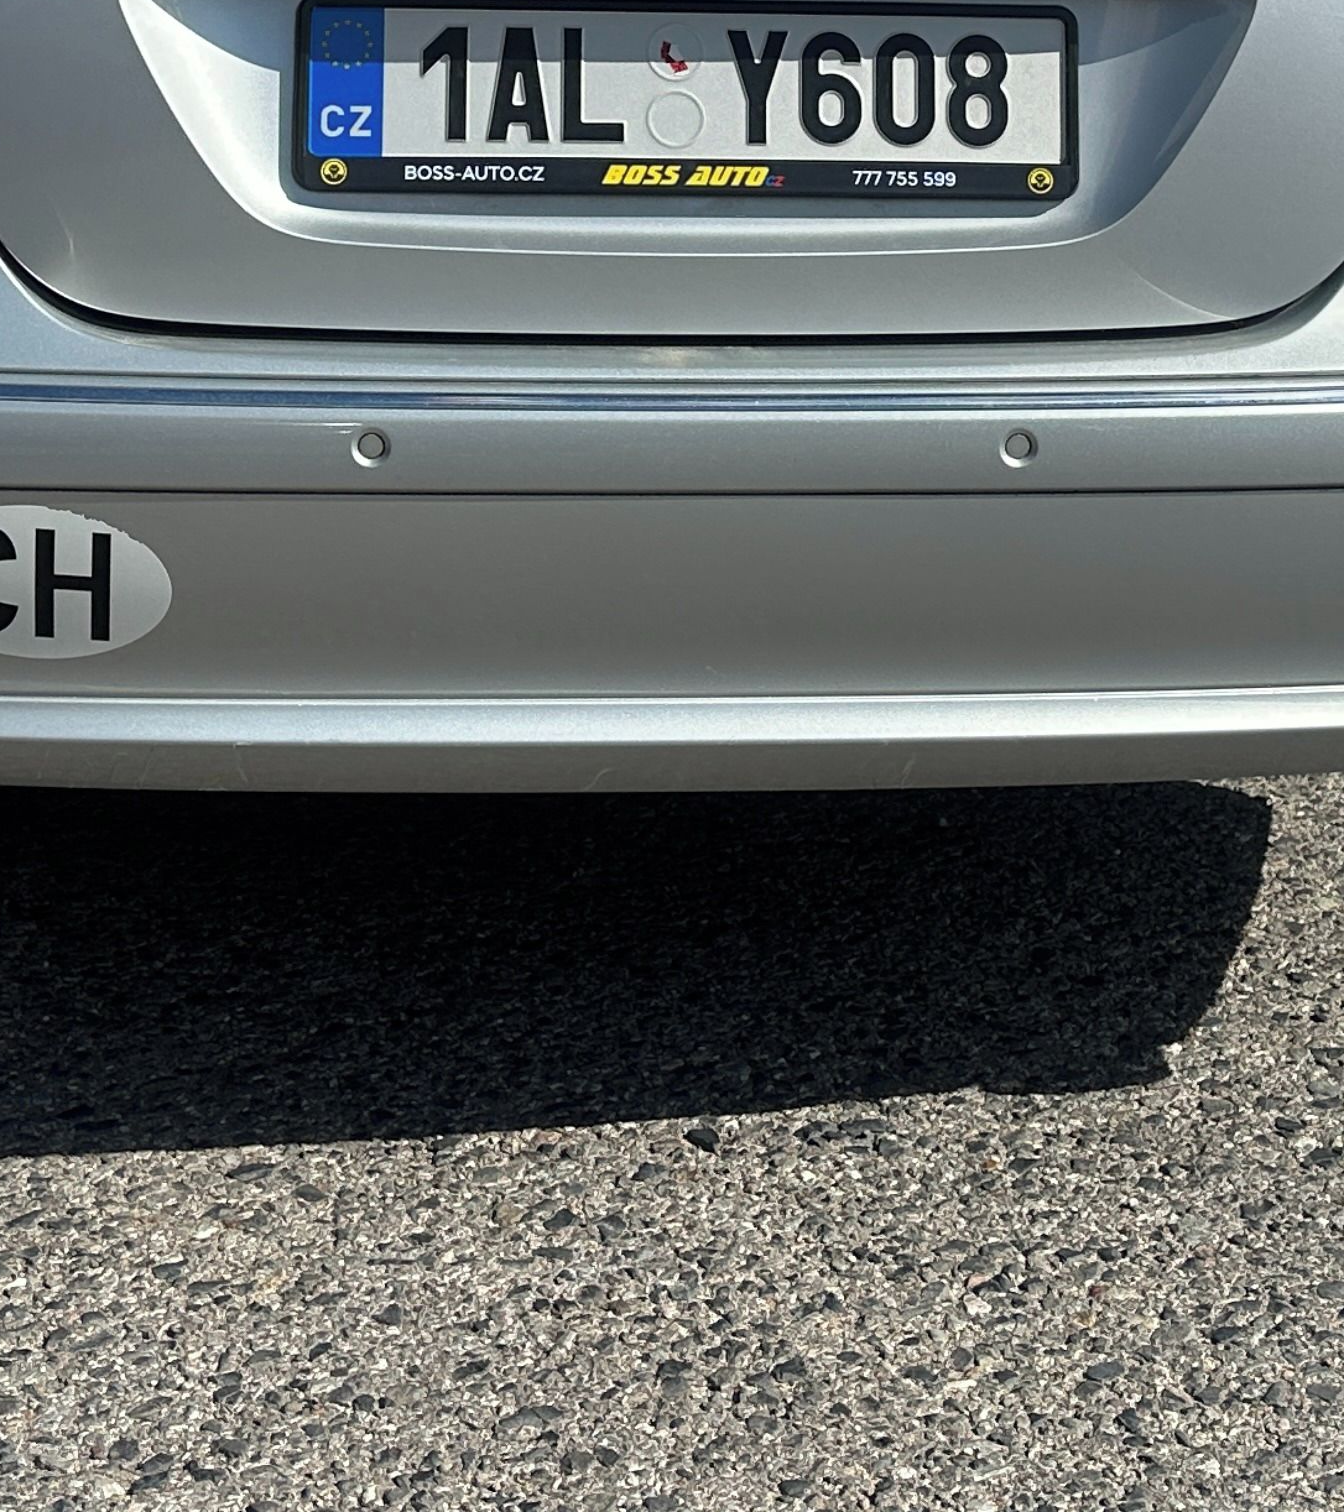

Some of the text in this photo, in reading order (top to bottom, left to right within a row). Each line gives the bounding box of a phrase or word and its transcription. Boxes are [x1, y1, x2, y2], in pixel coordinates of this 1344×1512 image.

[420, 26, 1009, 148] 1AL Y608
[320, 104, 372, 138] CZ
[404, 164, 545, 182] BOSS-AUTO.CZ
[602, 164, 682, 186] BOSS
[685, 165, 769, 187] AUTO
[852, 170, 956, 187] 777 755 599
